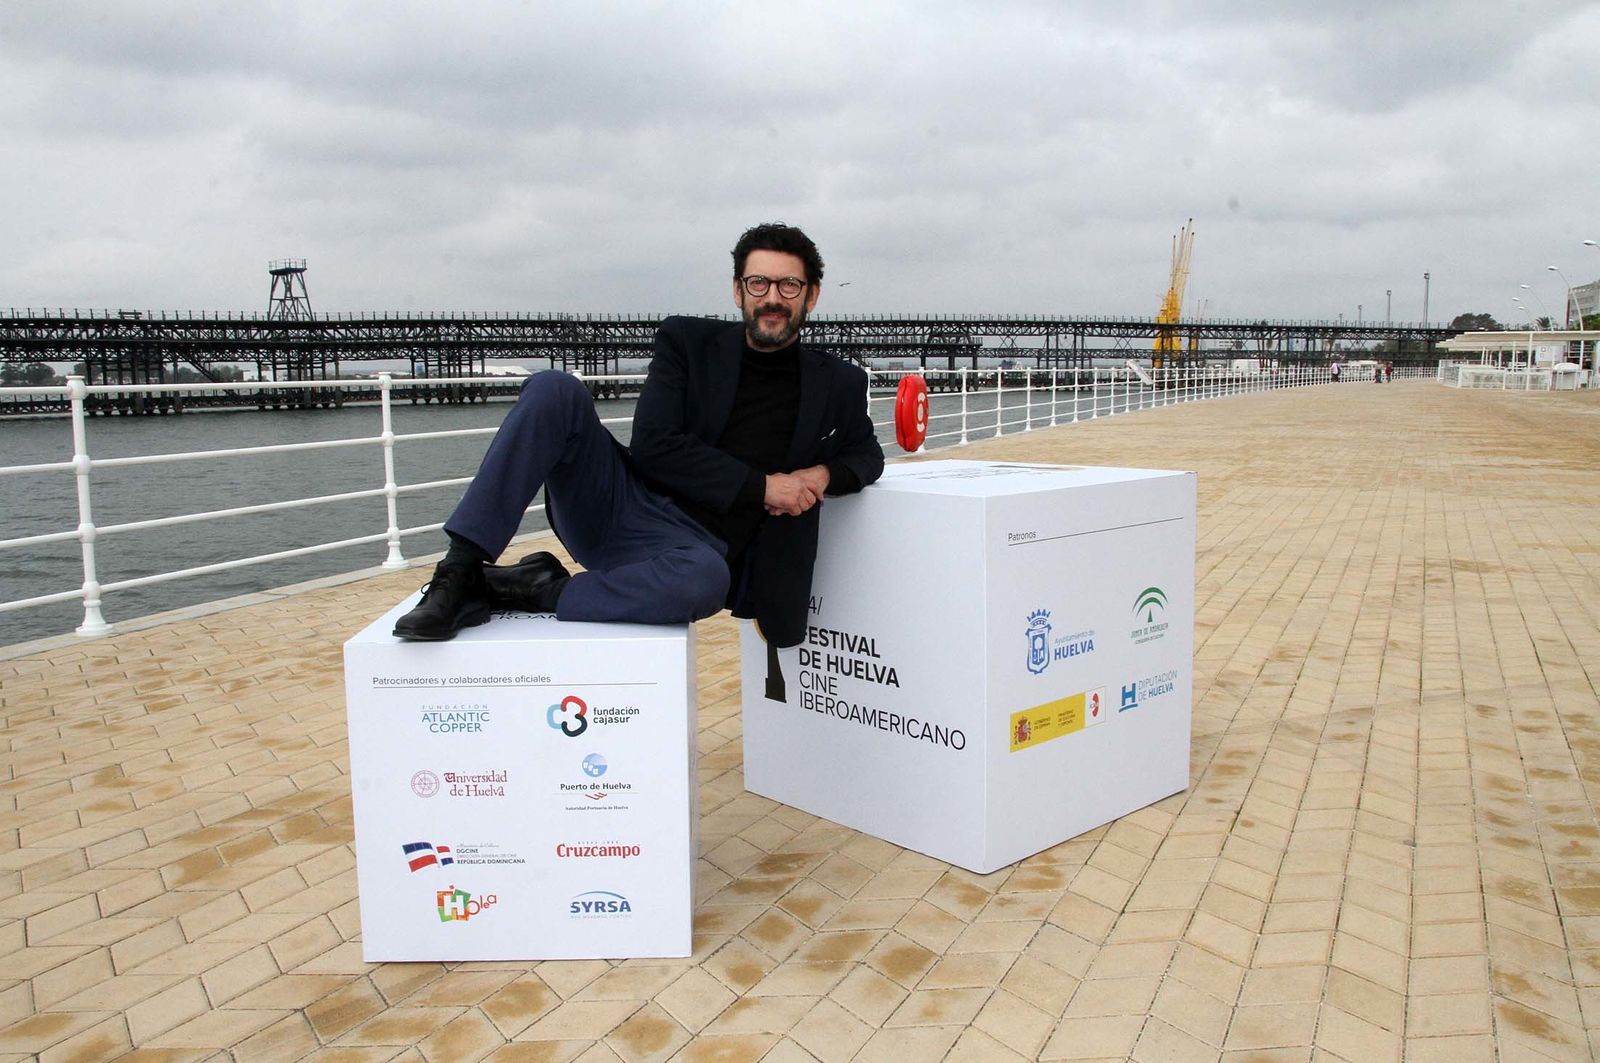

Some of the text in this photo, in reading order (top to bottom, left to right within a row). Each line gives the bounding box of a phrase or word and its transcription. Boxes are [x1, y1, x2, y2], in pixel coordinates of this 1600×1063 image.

[1008, 531, 1037, 542] Patronos
[805, 625, 881, 659] ESTIVAL
[1054, 639, 1095, 661] HUELVA
[798, 647, 900, 689] DE HUELVA
[372, 674, 552, 686] Patrocinadores y colaboradores oficiales
[799, 670, 838, 697] CINE
[1138, 682, 1175, 702] DE HUELVA
[421, 711, 491, 723] ATLANTIC
[593, 706, 641, 716] fundación
[429, 722, 483, 733] COPPER
[593, 715, 631, 726] cajasur
[799, 690, 967, 751] IBEROAMERICANO
[443, 769, 508, 783] Universidad
[449, 784, 505, 797] de Huelva
[560, 782, 632, 791] Puerto de Huelva
[556, 842, 641, 859] Cruzcampo
[569, 900, 632, 914] SYRSA
